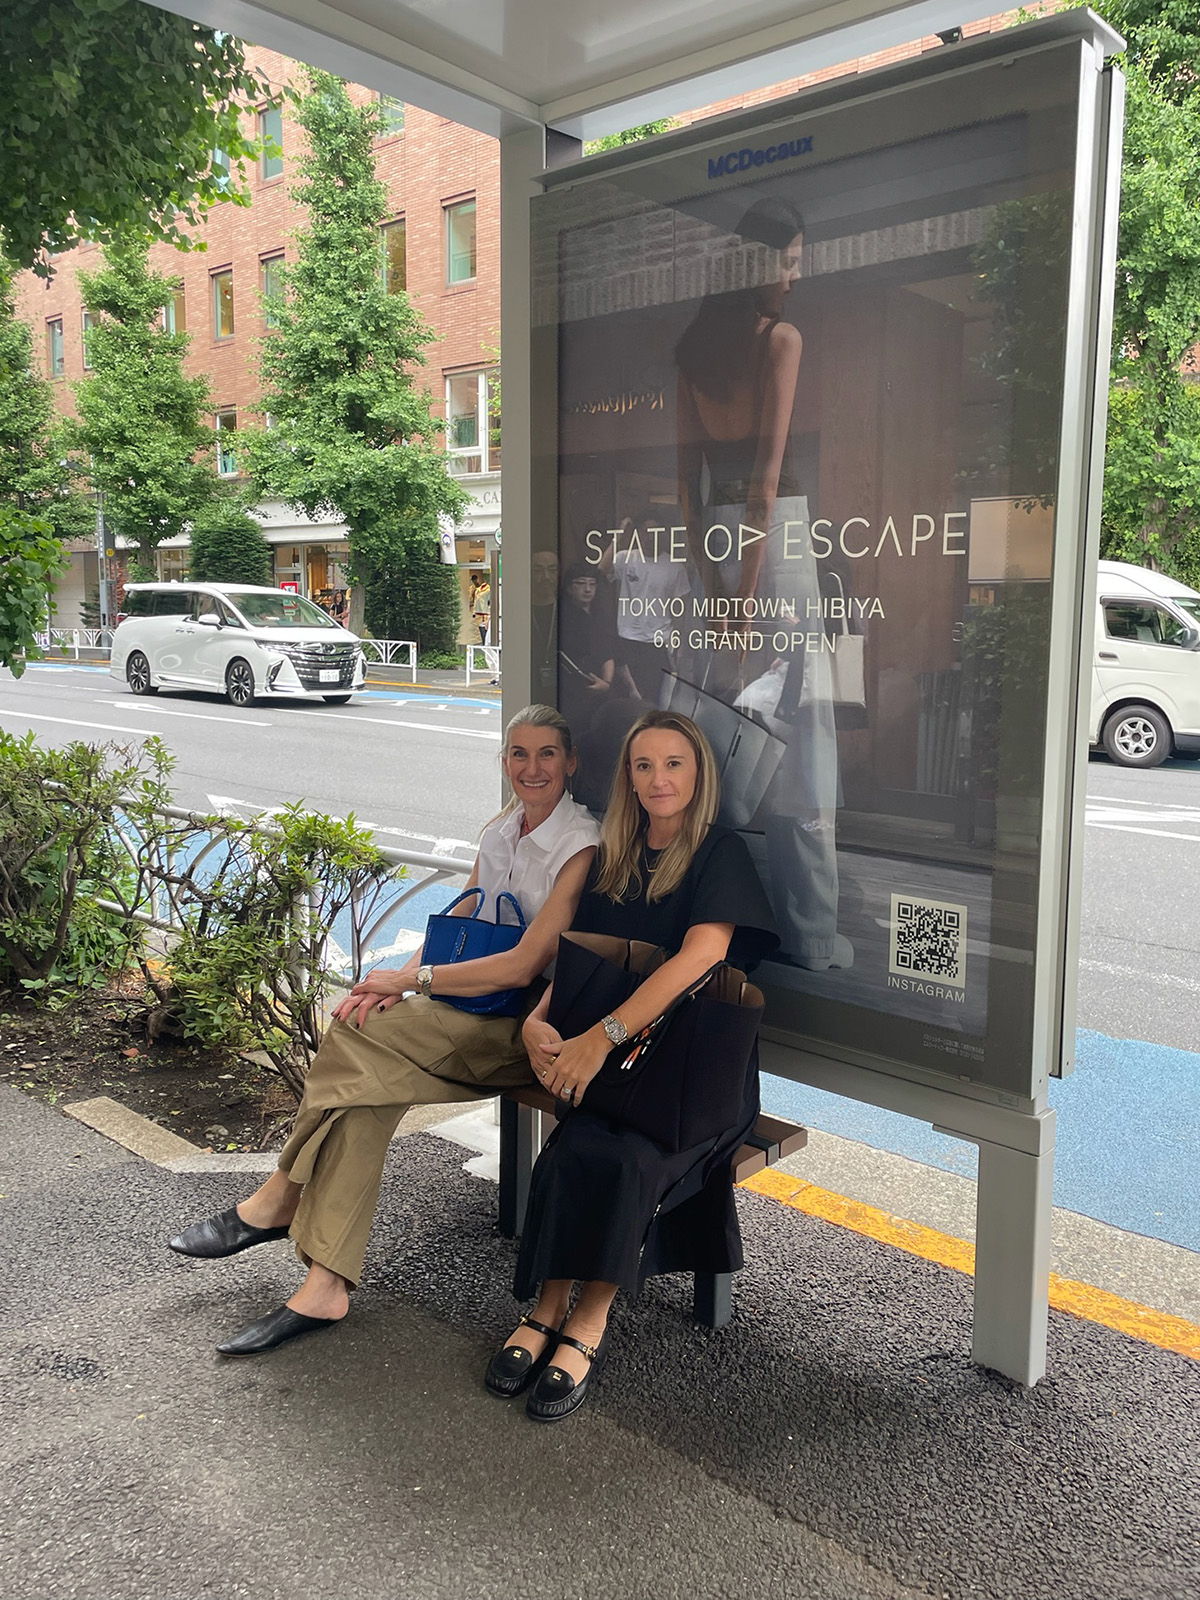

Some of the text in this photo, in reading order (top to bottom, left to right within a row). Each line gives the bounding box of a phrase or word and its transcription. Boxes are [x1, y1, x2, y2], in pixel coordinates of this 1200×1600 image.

[707, 136, 814, 179] MCDecaux
[584, 526, 688, 565] STATE
[783, 512, 968, 560] ESCAPE
[619, 597, 885, 620] TOKYO MIDTOWN HIBIYA
[653, 629, 837, 654] 6.6 GRAND OPEN
[887, 976, 966, 1004] INSTAGRAM
